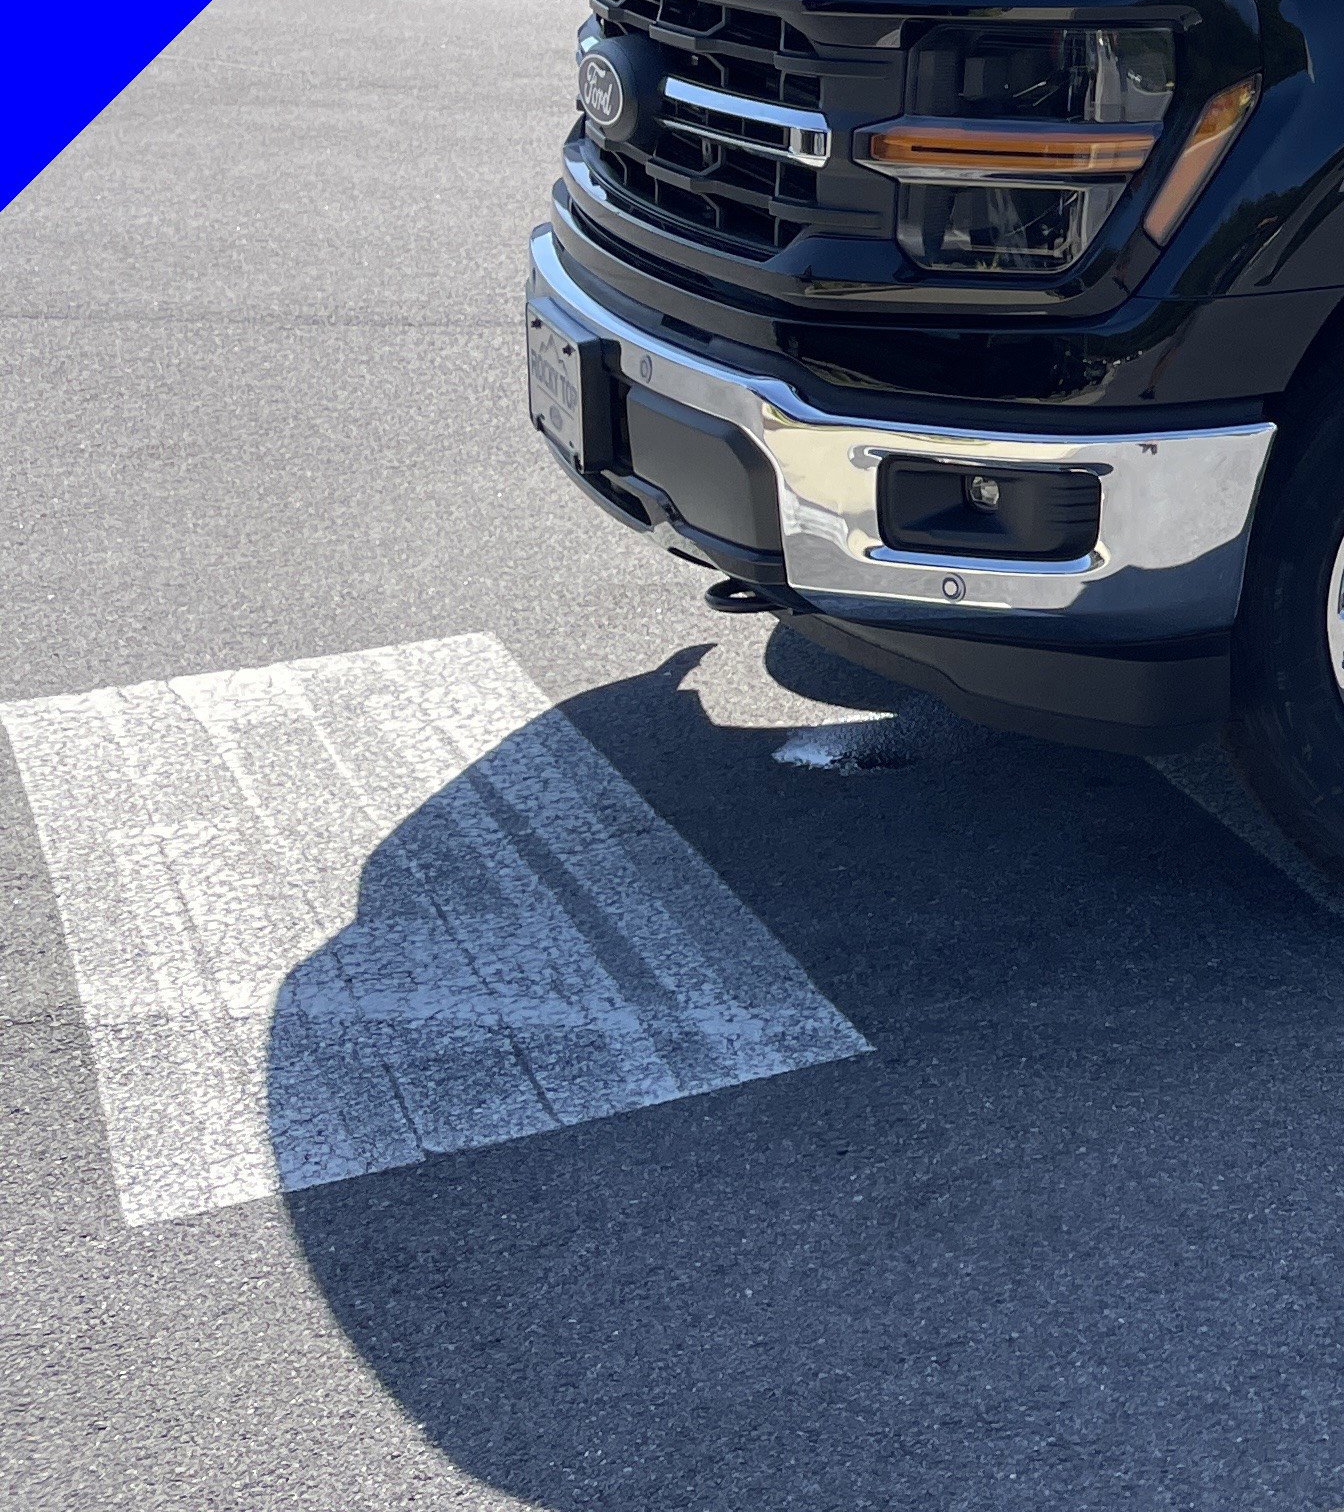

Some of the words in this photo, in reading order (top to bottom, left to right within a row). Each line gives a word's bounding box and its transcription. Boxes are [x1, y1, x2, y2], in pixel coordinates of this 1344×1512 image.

[584, 61, 613, 116] Ford
[530, 347, 559, 399] ROCKY
[559, 373, 578, 412] TOP
